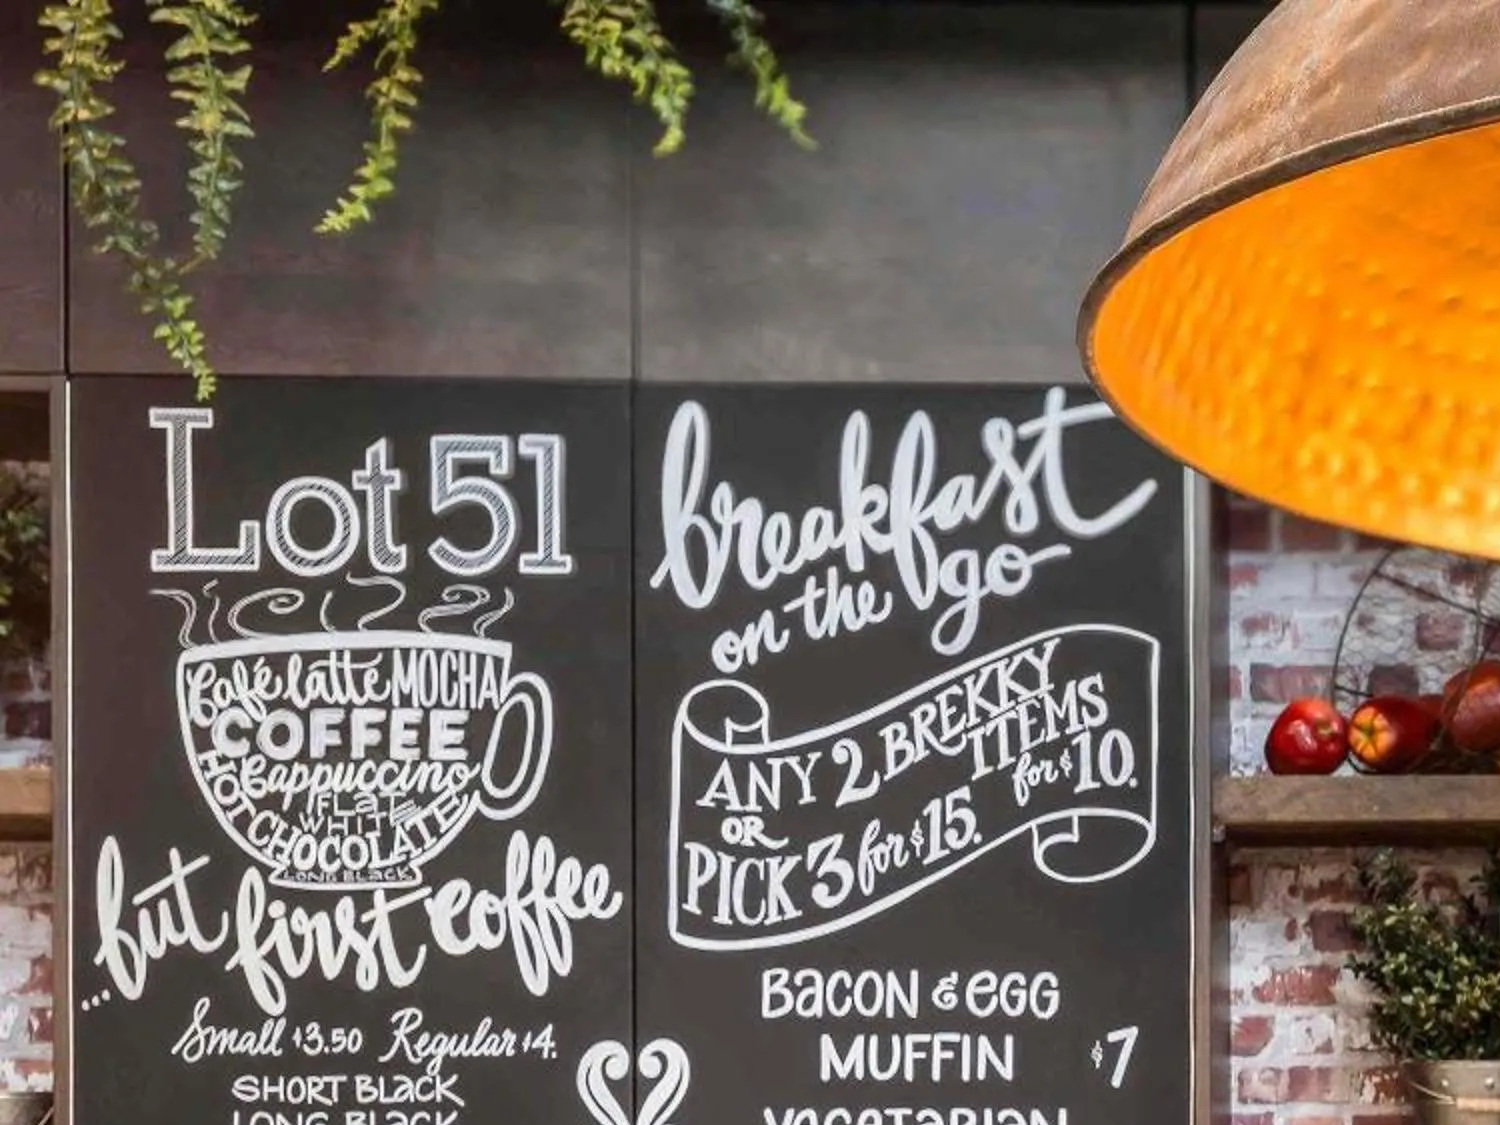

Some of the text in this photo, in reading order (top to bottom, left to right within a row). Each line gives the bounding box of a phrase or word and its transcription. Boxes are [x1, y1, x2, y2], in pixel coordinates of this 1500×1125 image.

[149, 408, 574, 577] Lot 51
[650, 385, 1158, 609] breakfast
[711, 543, 1071, 673] on the go
[392, 649, 499, 710] MOCHA
[211, 706, 471, 760] COFFEE
[696, 637, 1062, 813] ANY 2 BREKKY
[967, 672, 1109, 782] ITEMS
[241, 753, 480, 816] Cappuccino
[1012, 752, 1059, 807] for
[248, 786, 470, 872] CHOCOLATE
[720, 816, 789, 850] OR
[682, 841, 803, 926] PICK
[807, 833, 855, 909] 3
[857, 818, 911, 897] for
[226, 867, 432, 1016] first
[424, 830, 622, 997] coffee
[171, 997, 286, 1063] Small
[378, 1007, 516, 1076] Regular
[820, 1026, 1139, 1088] MUFFIN $7
[231, 1074, 347, 1105] SHORT
